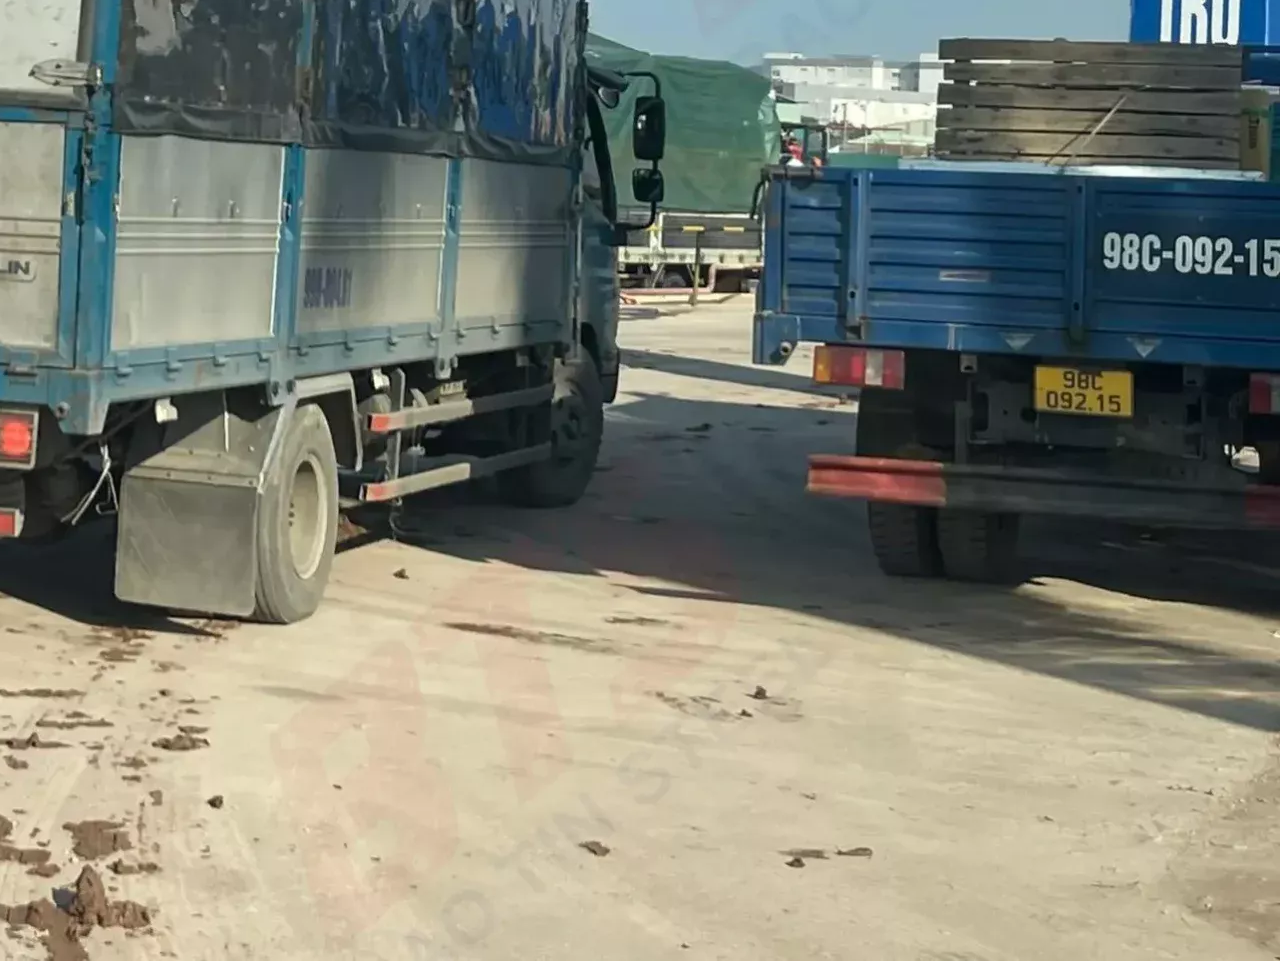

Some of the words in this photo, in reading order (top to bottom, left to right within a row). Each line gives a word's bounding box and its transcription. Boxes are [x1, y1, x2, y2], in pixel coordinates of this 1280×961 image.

[1103, 231, 1280, 278] 98C-092-15
[1062, 370, 1104, 391] 98C
[1046, 391, 1121, 413] 092.15
